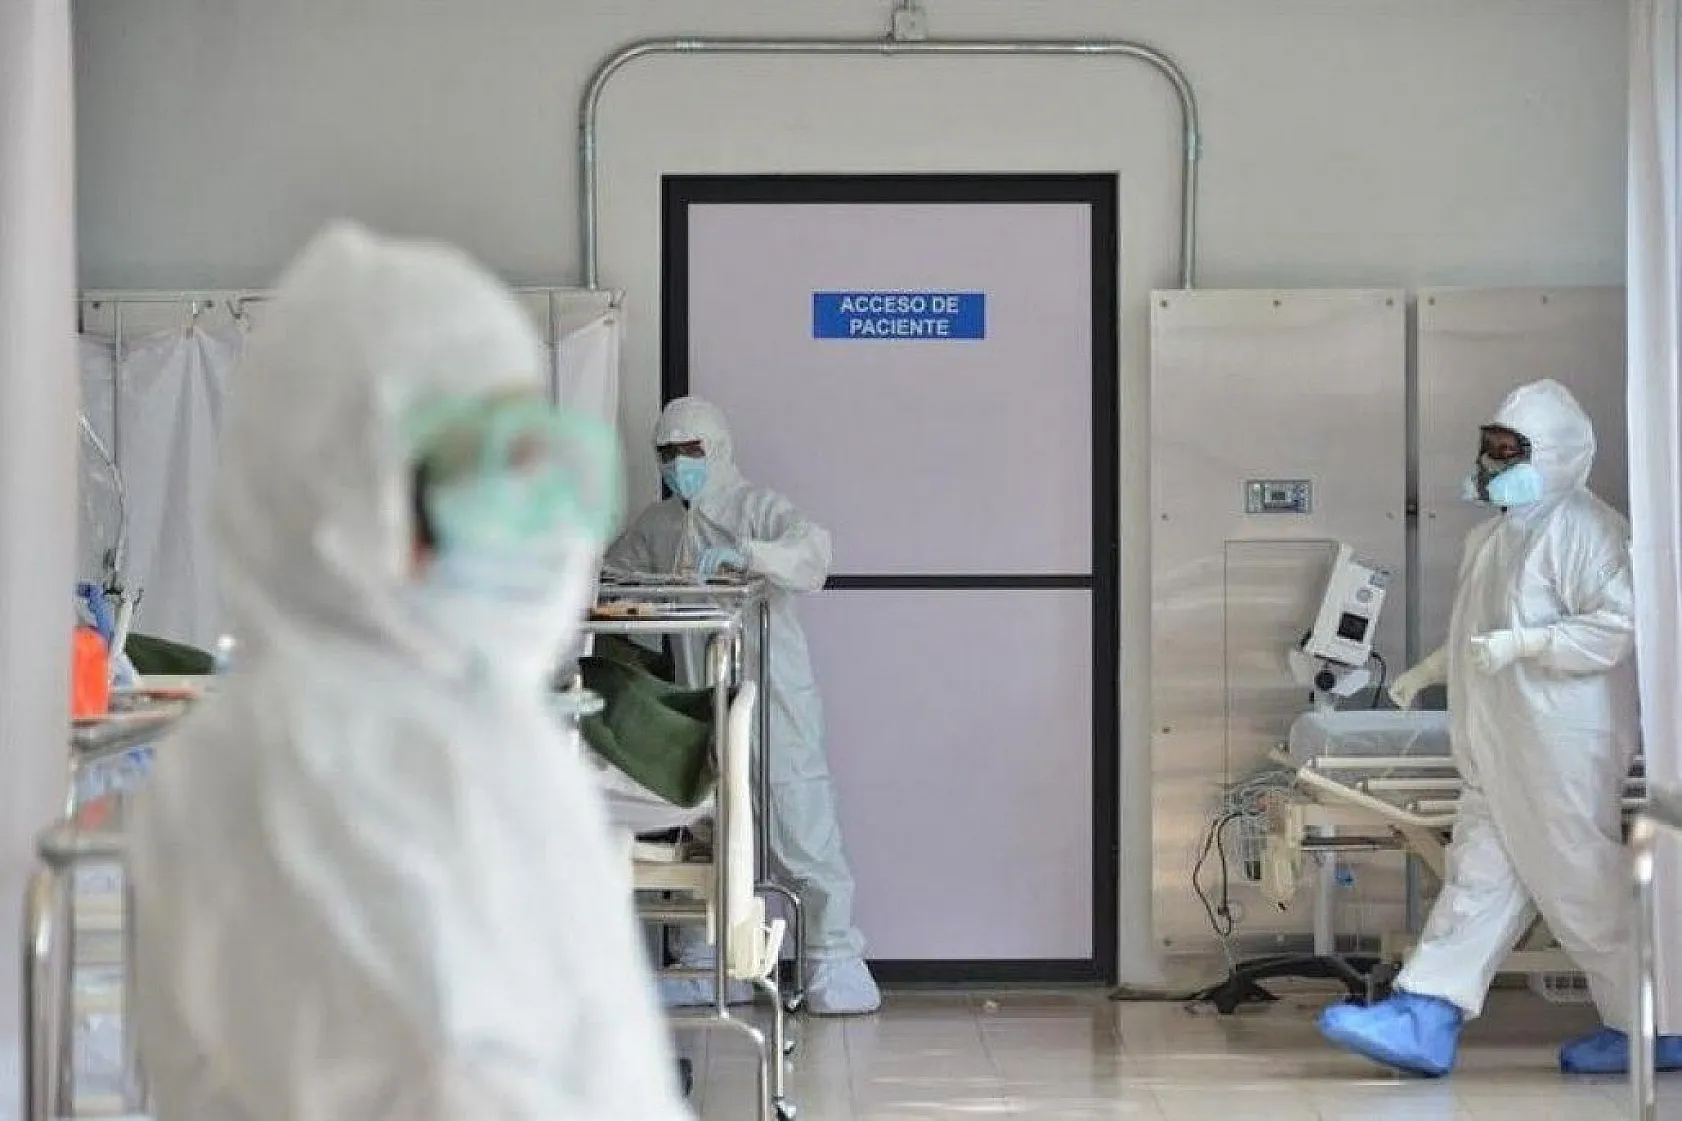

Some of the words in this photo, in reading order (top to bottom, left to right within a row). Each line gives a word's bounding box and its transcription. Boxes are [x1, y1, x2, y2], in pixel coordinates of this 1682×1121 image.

[840, 296, 924, 313] ACCESO
[932, 296, 959, 313] DE
[850, 319, 949, 336] PACIENTE
